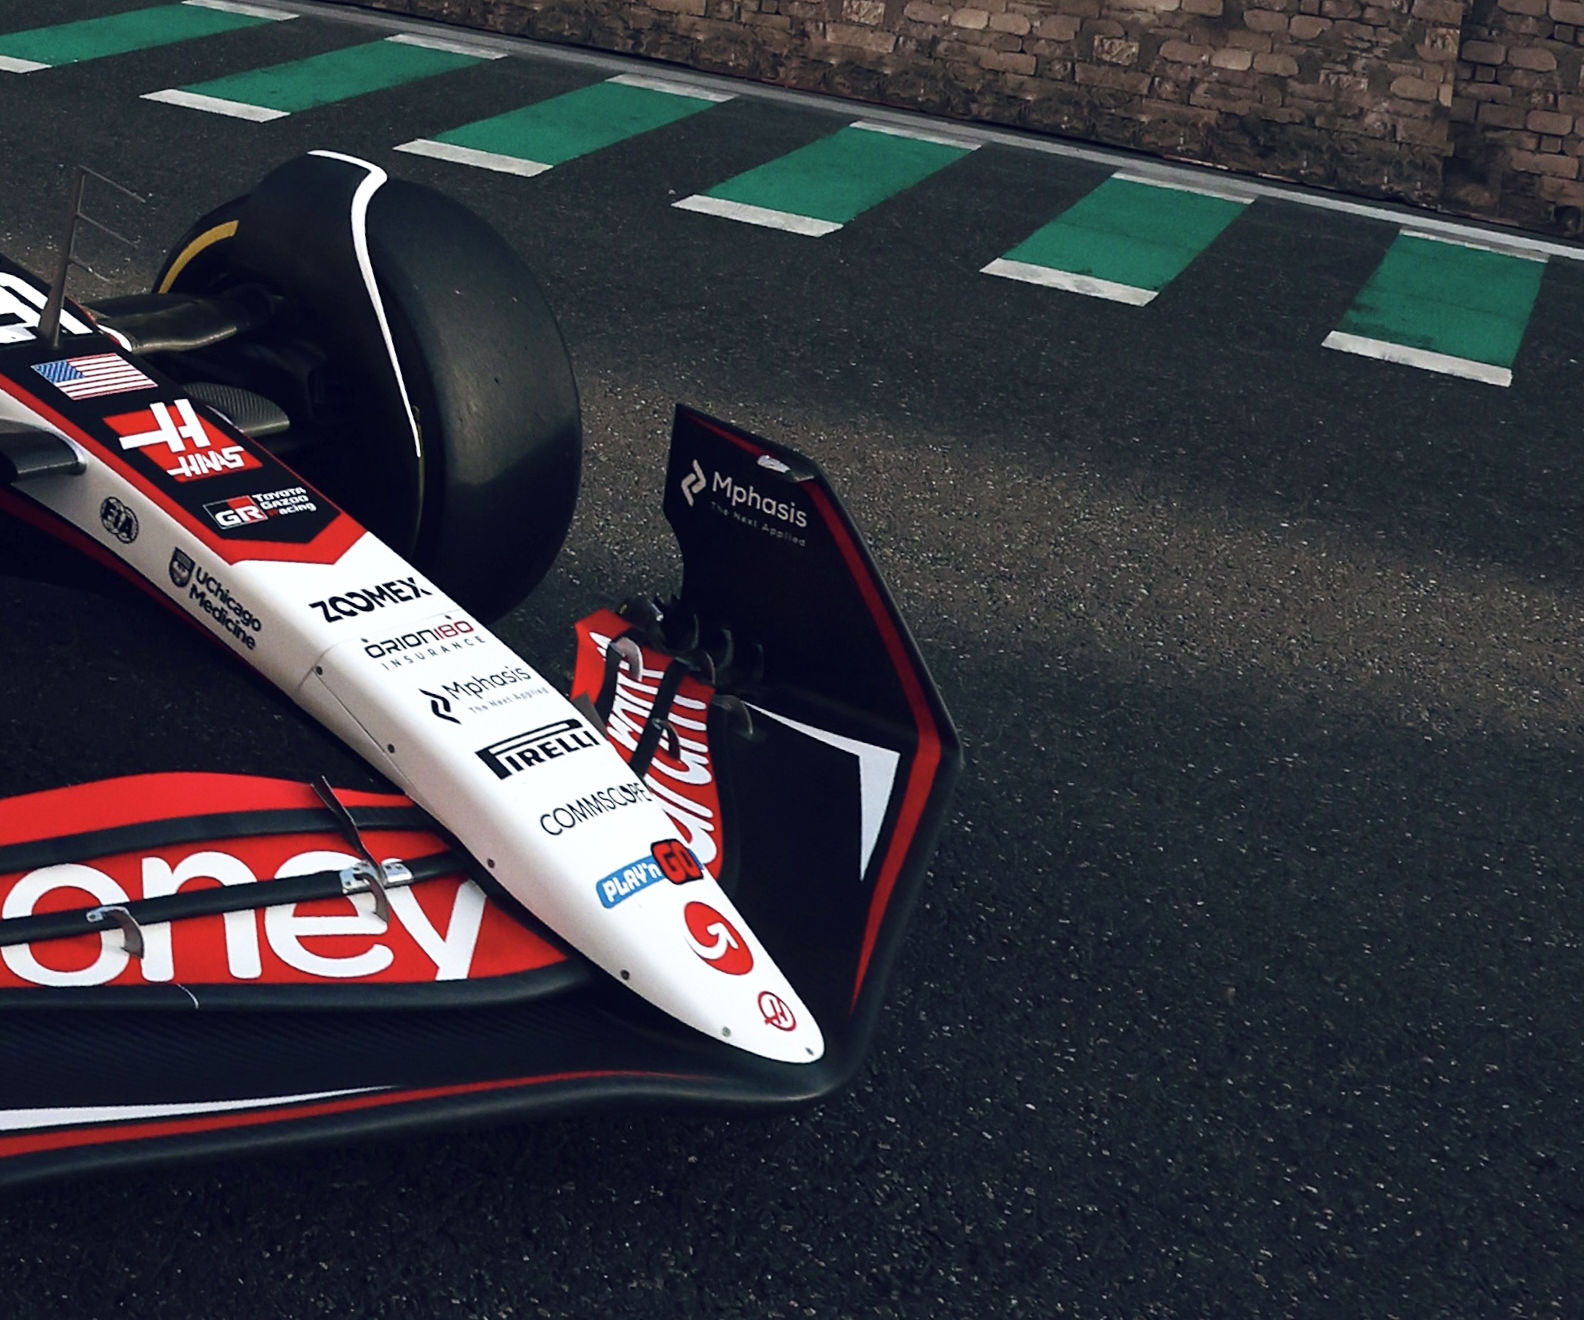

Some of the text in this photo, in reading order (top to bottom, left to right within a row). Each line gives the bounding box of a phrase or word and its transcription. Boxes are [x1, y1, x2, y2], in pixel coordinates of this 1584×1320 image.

[167, 445, 245, 477] HAAS
[215, 505, 263, 527] GR
[268, 502, 317, 518] Racing
[712, 471, 807, 528] Mphasis
[102, 500, 137, 541] FIA
[189, 584, 256, 650] Medicine
[195, 566, 262, 632] UChicago
[308, 577, 433, 623] ZOOMEX
[364, 621, 474, 659] ORION180
[380, 635, 486, 671] INSURANCE
[441, 665, 531, 700] Mphasis
[490, 696, 513, 709] Next
[474, 718, 601, 780] PIRELLI
[540, 783, 653, 836] COMMSCOPE
[653, 839, 703, 885] GO
